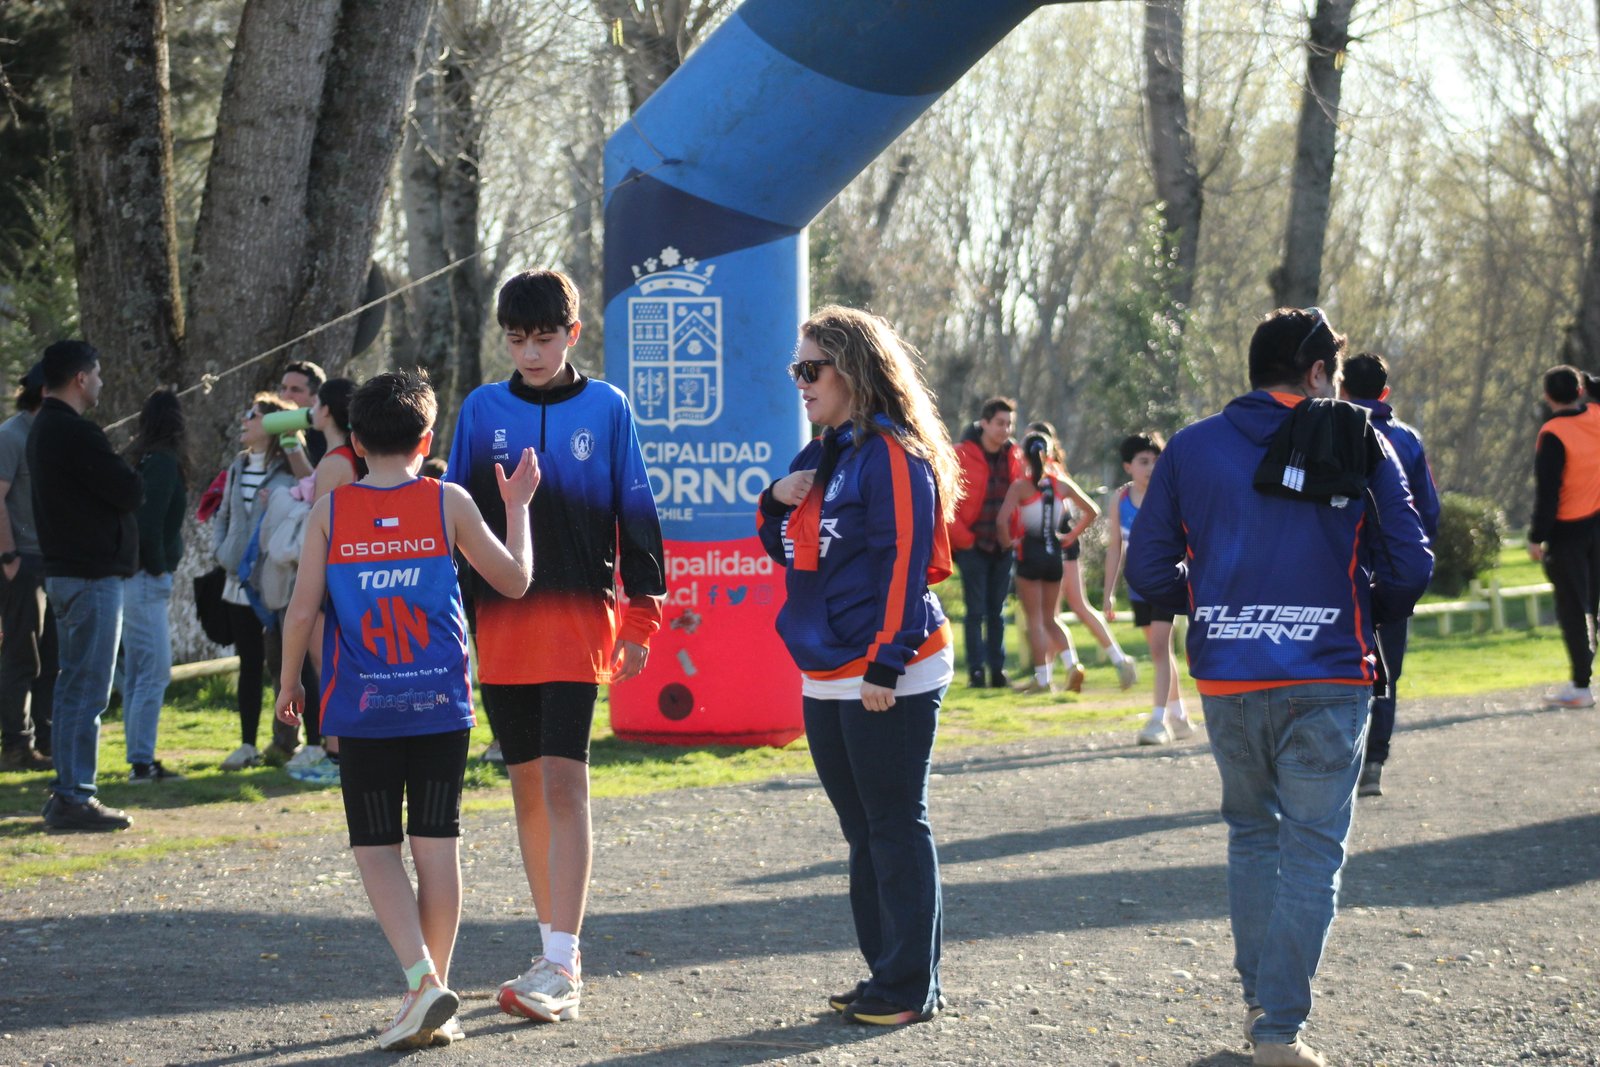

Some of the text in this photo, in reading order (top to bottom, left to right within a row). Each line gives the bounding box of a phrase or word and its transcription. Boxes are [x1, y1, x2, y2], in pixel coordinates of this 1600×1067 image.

[642, 441, 772, 463] CIPALIDAD
[340, 537, 436, 557] OSORNO
[664, 550, 774, 581] ipalidad
[358, 568, 420, 590] TOMI
[1194, 605, 1341, 624] ATLETISMO
[361, 595, 430, 665] HN
[1206, 623, 1320, 645] OSORNO
